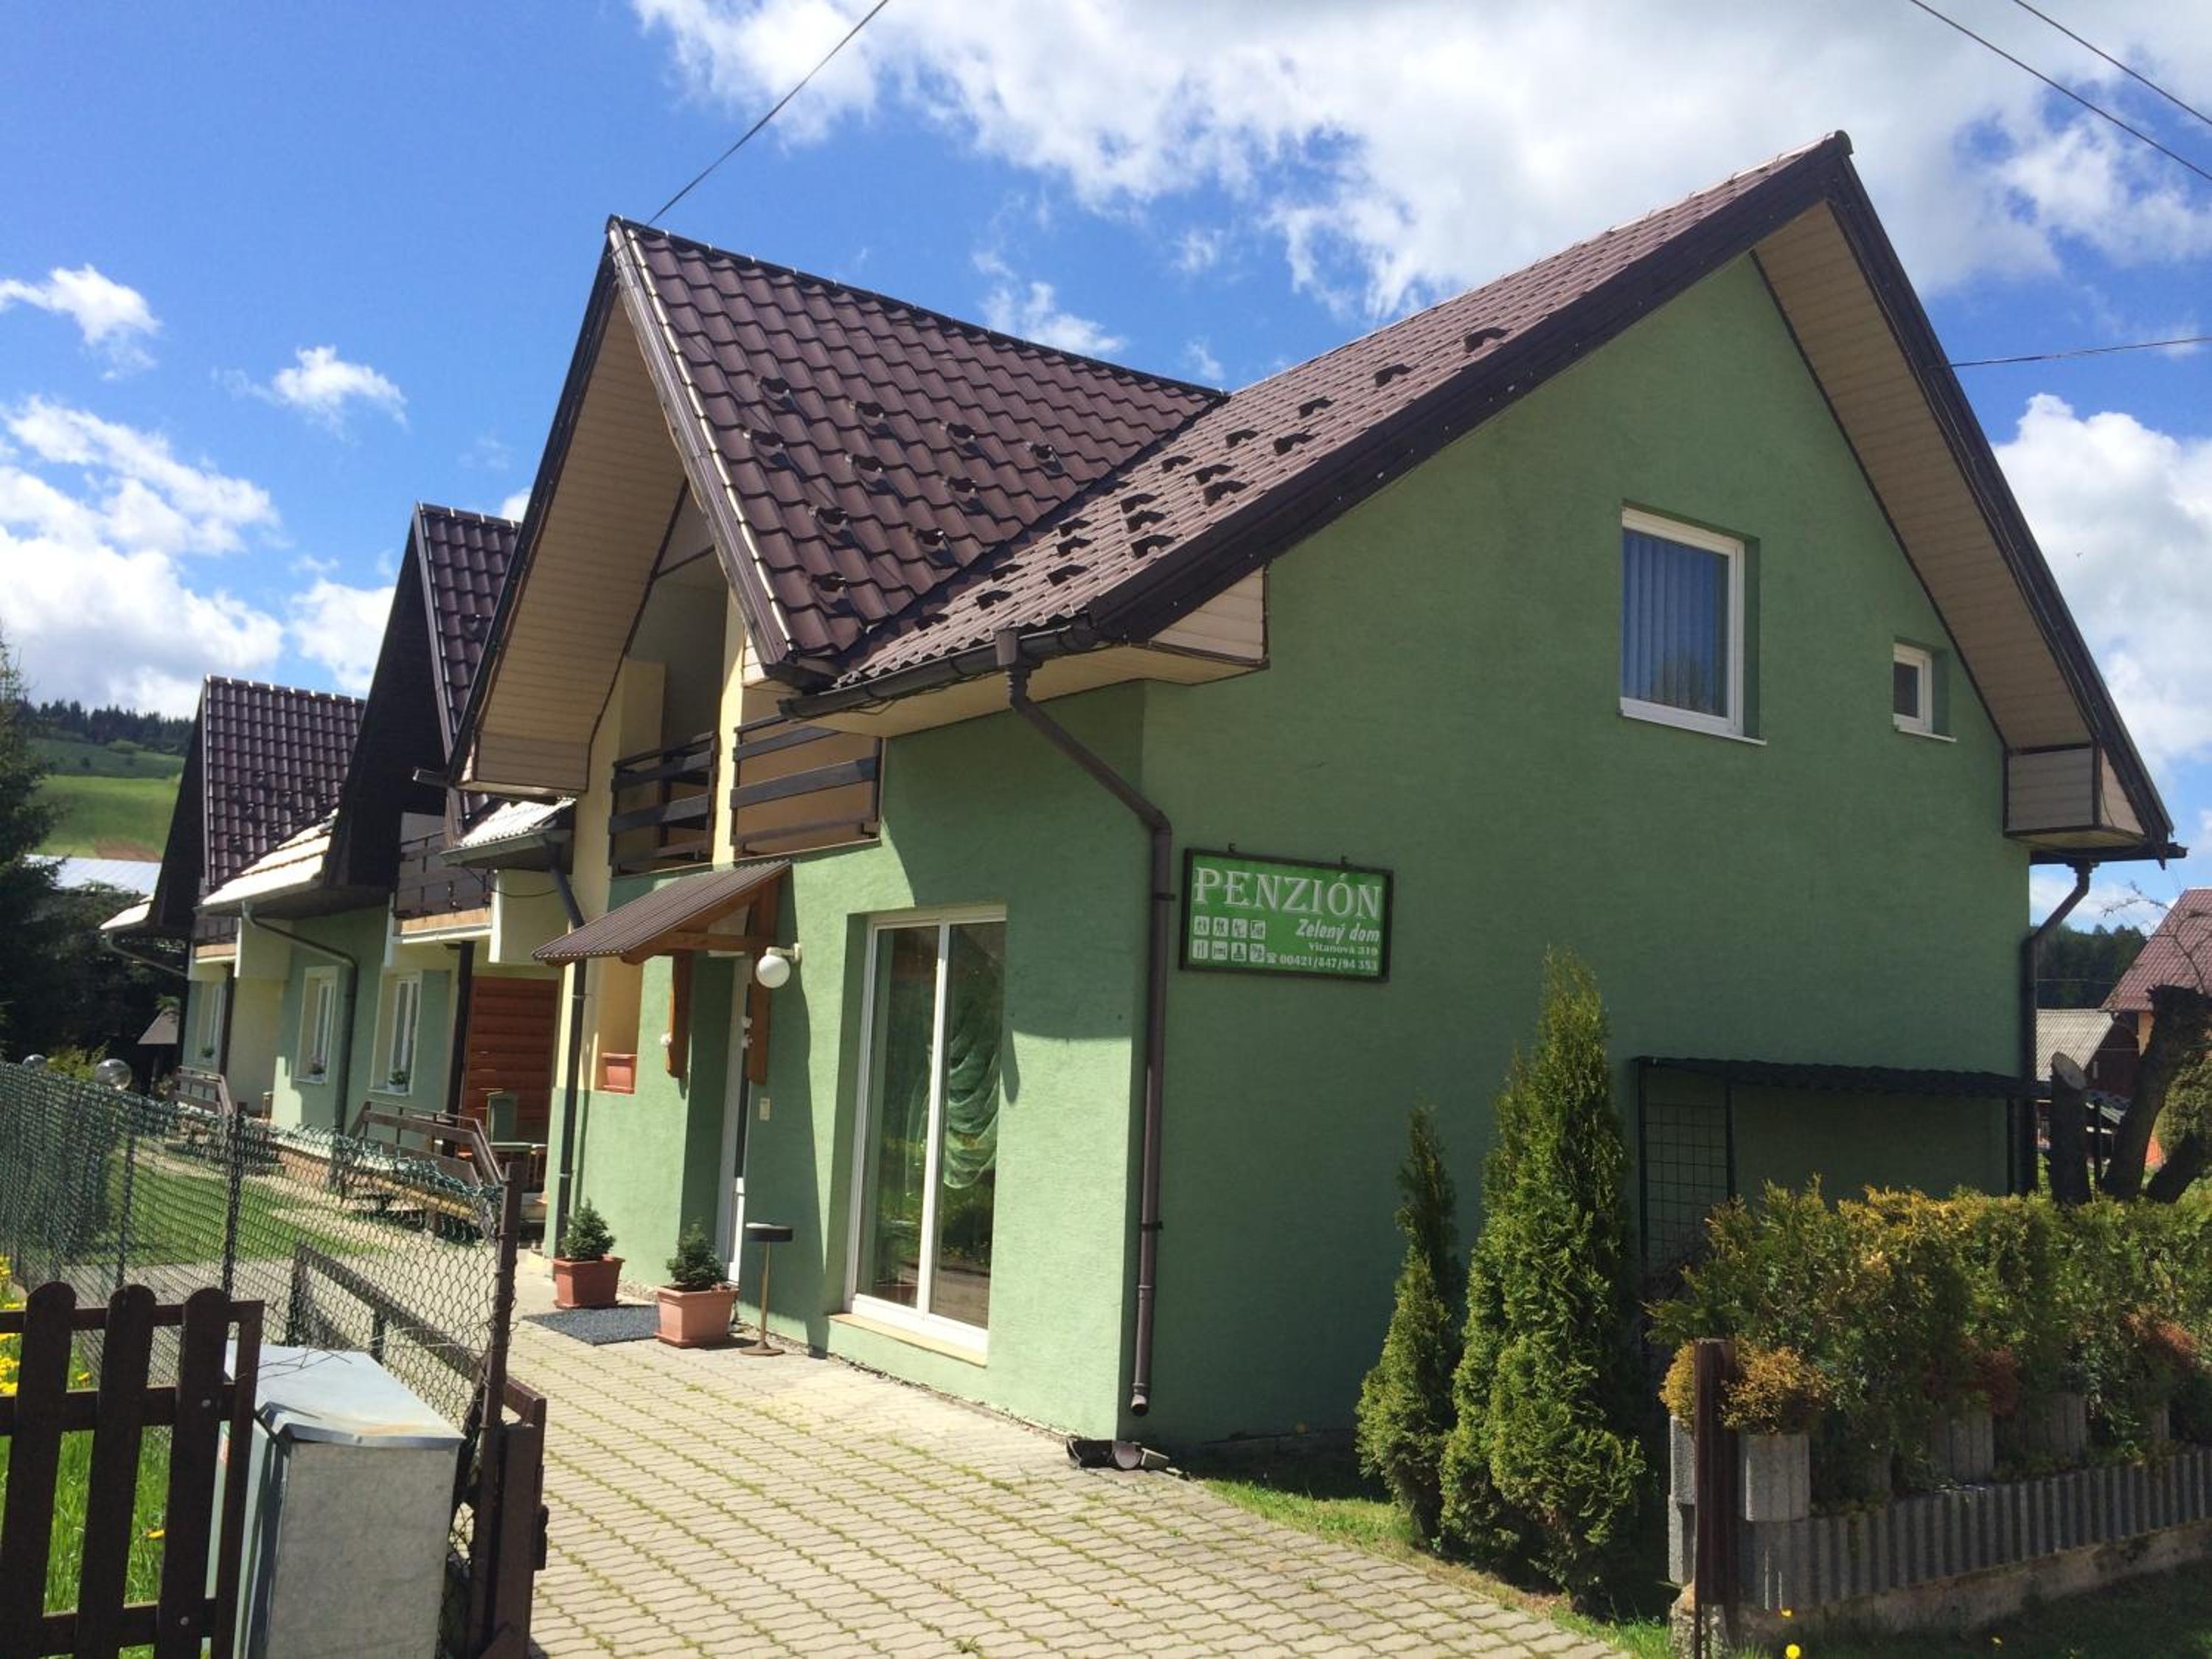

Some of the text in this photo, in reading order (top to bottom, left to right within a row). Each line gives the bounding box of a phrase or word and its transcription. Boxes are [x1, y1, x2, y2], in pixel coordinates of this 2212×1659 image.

[1193, 866, 1382, 919] PENZIÓN
[1295, 919, 1380, 945] Zelený dom
